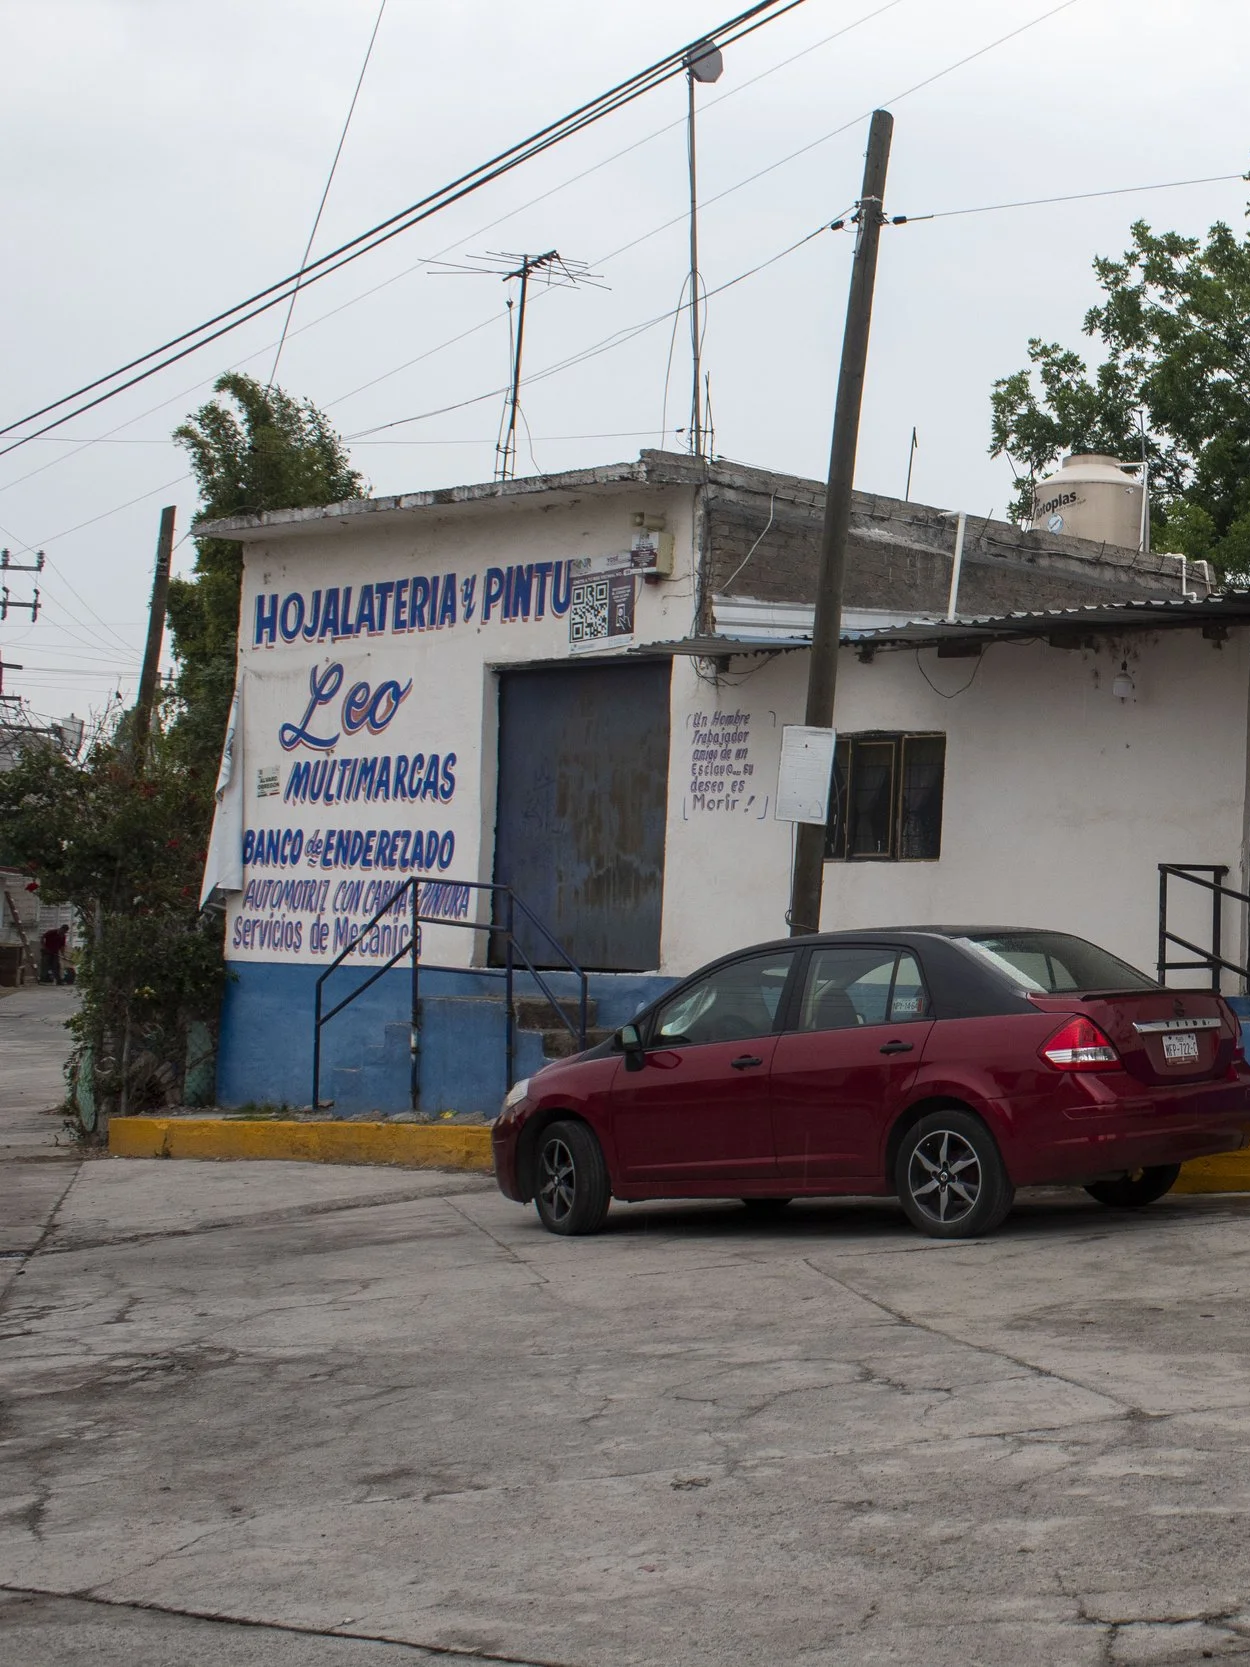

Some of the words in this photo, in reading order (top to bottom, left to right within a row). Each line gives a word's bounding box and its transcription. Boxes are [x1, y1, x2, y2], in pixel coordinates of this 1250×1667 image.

[252, 573, 457, 650] HOJALATERIA
[279, 662, 413, 751] Leo
[692, 711, 708, 728] Un
[711, 709, 750, 727] Hombre
[691, 726, 750, 747] Trabajador
[720, 744, 732, 761] de
[283, 752, 458, 806] MULTIMARCAS
[690, 776, 724, 793] deseo
[731, 780, 745, 793] es
[243, 829, 304, 869] BANCO
[304, 829, 324, 864] de
[319, 829, 455, 872] ENDEREZADO
[241, 879, 331, 914] AUTOMOTRIZ
[332, 879, 365, 916] CON
[232, 912, 302, 950] Servicios
[309, 914, 330, 955] de
